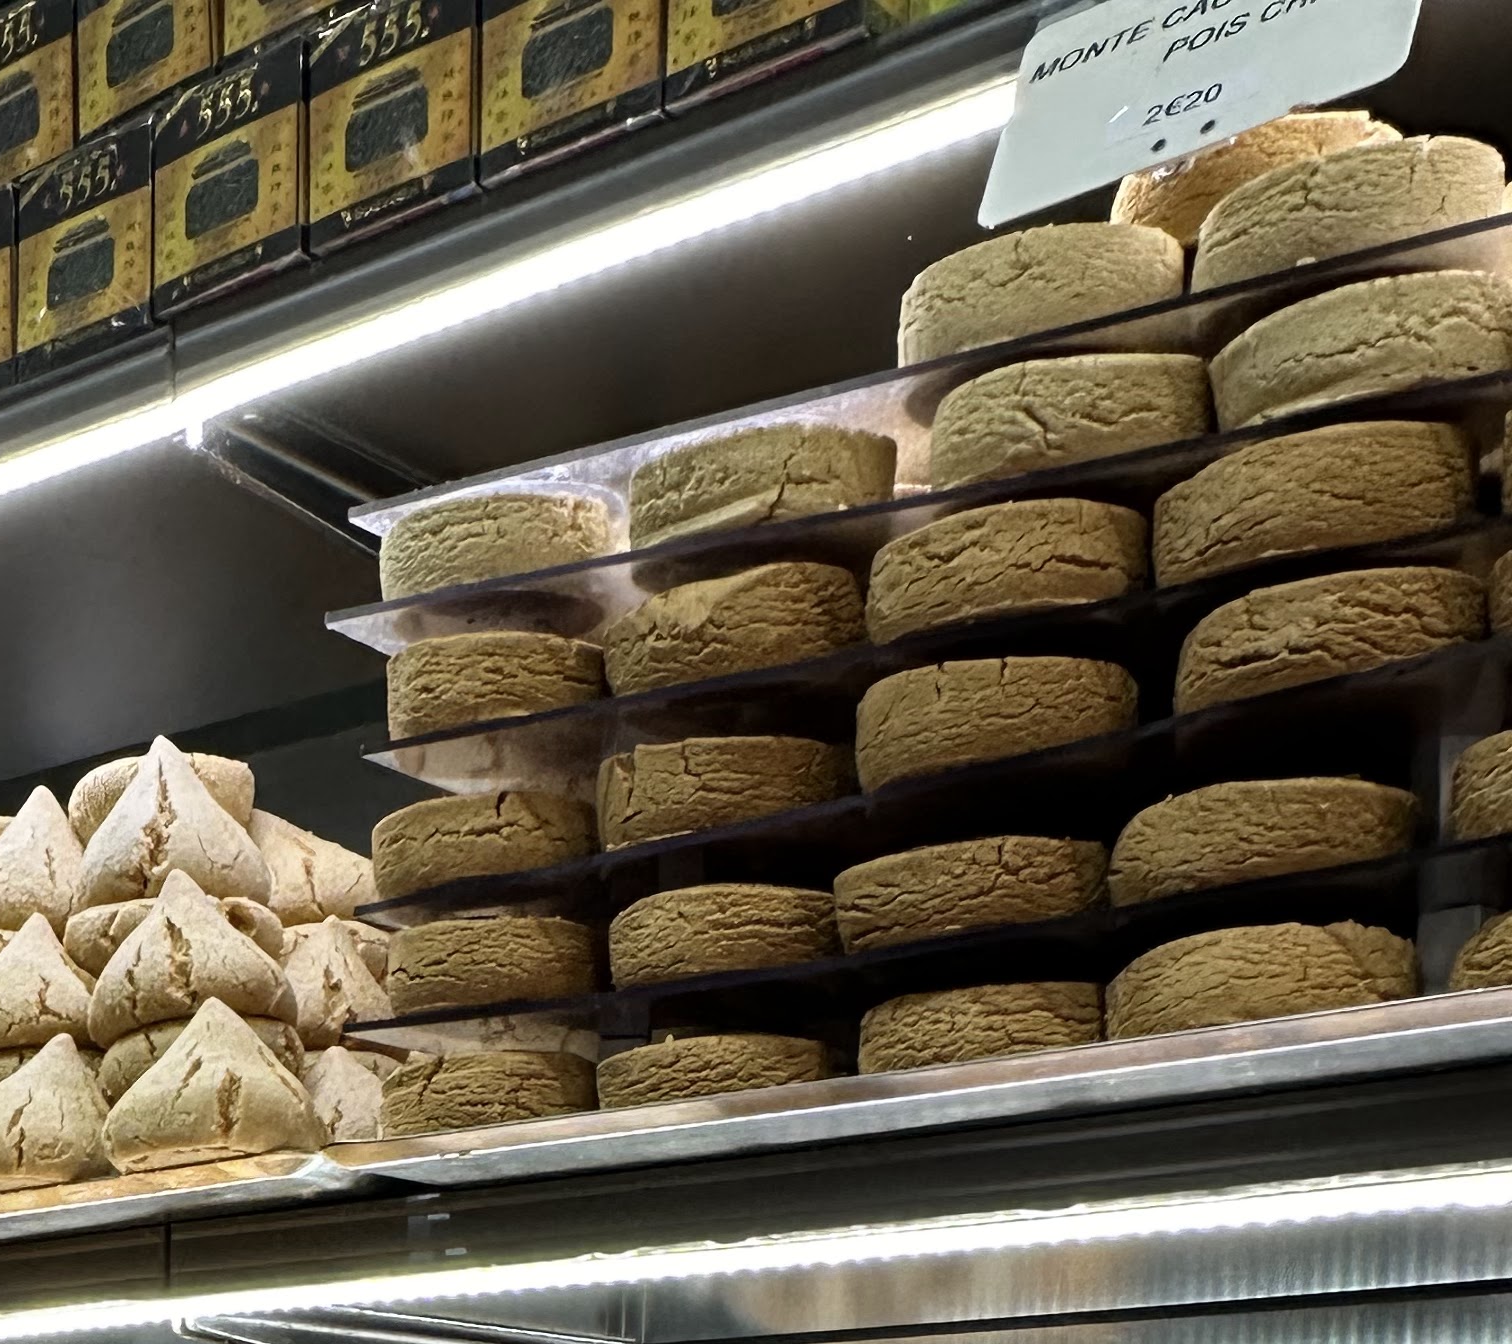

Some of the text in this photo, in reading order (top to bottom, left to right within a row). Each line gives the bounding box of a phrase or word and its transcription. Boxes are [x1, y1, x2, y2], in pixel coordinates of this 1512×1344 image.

[1029, 17, 1155, 84] MONTE
[1163, 12, 1250, 63] POIS
[1142, 83, 1223, 126] 2€20
